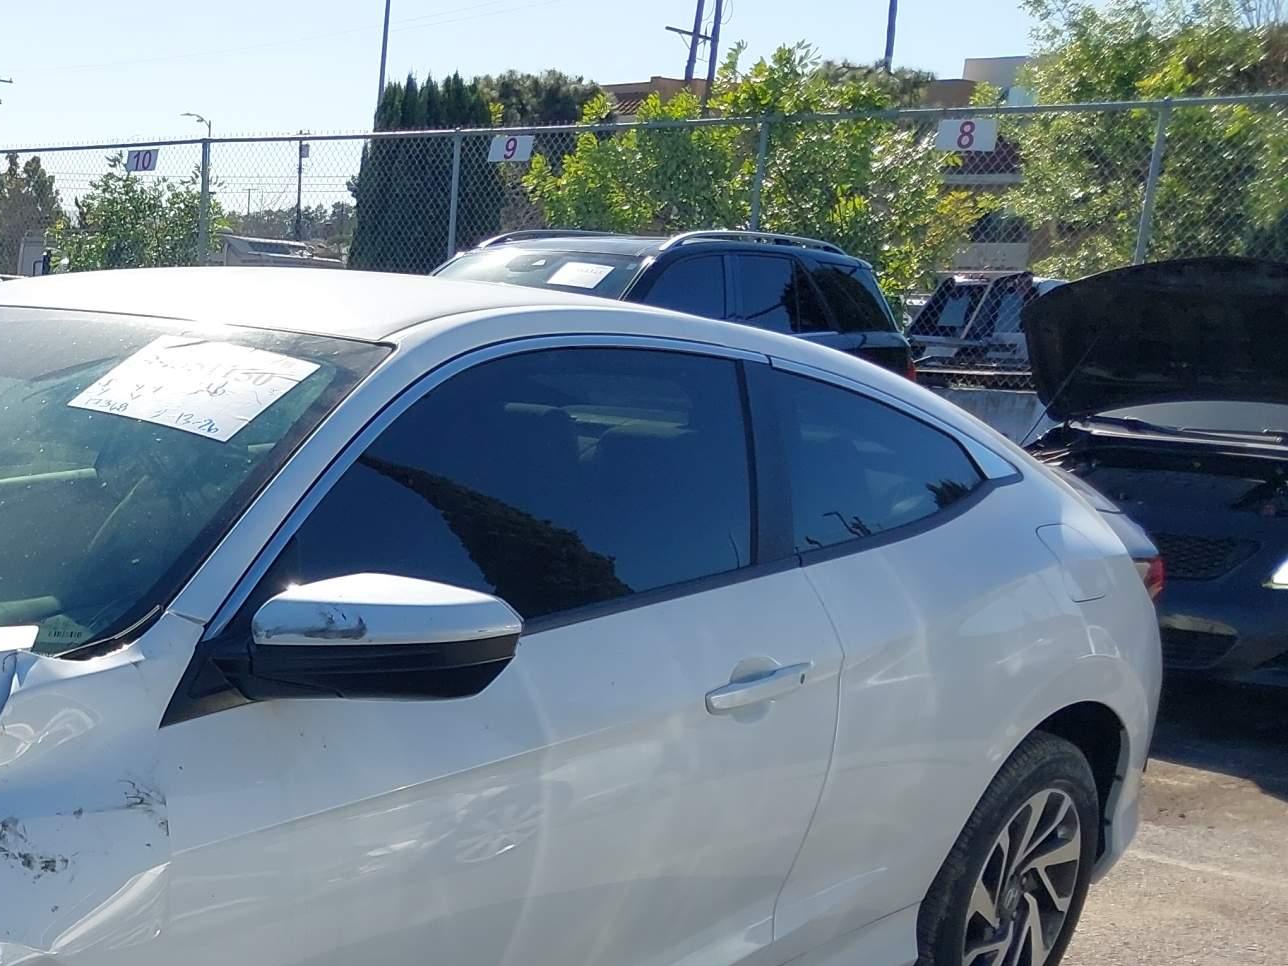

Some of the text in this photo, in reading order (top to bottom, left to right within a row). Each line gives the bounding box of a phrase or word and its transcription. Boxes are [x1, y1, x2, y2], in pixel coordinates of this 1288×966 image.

[957, 121, 976, 149] 8
[133, 150, 152, 170] 10
[504, 137, 518, 160] 9
